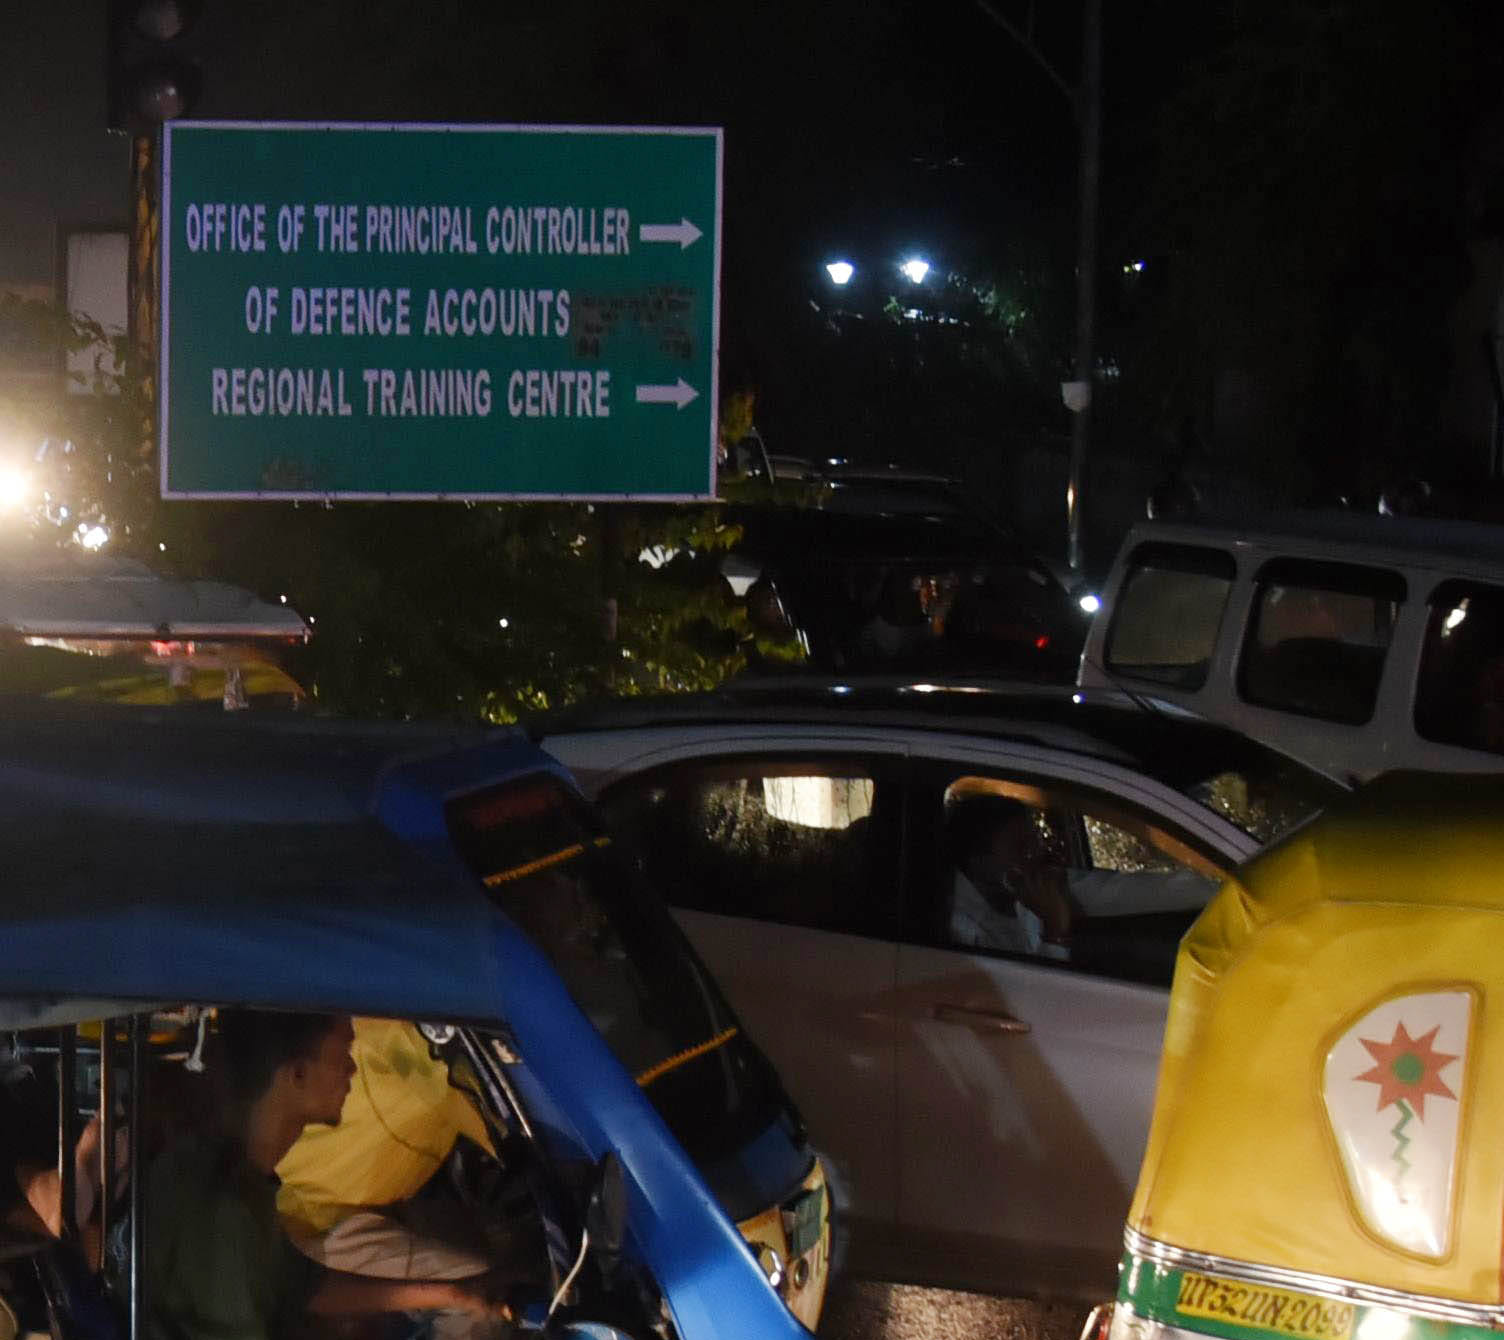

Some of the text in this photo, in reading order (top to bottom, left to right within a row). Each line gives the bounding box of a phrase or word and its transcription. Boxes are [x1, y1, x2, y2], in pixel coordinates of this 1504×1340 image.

[186, 203, 630, 256] OFFICE OF THE PRINCIPAL CONTROLLER
[245, 286, 571, 337] OF DEFENCE ACCOUNTS
[211, 367, 610, 417] REGIONAL TRAINING CENTRE
